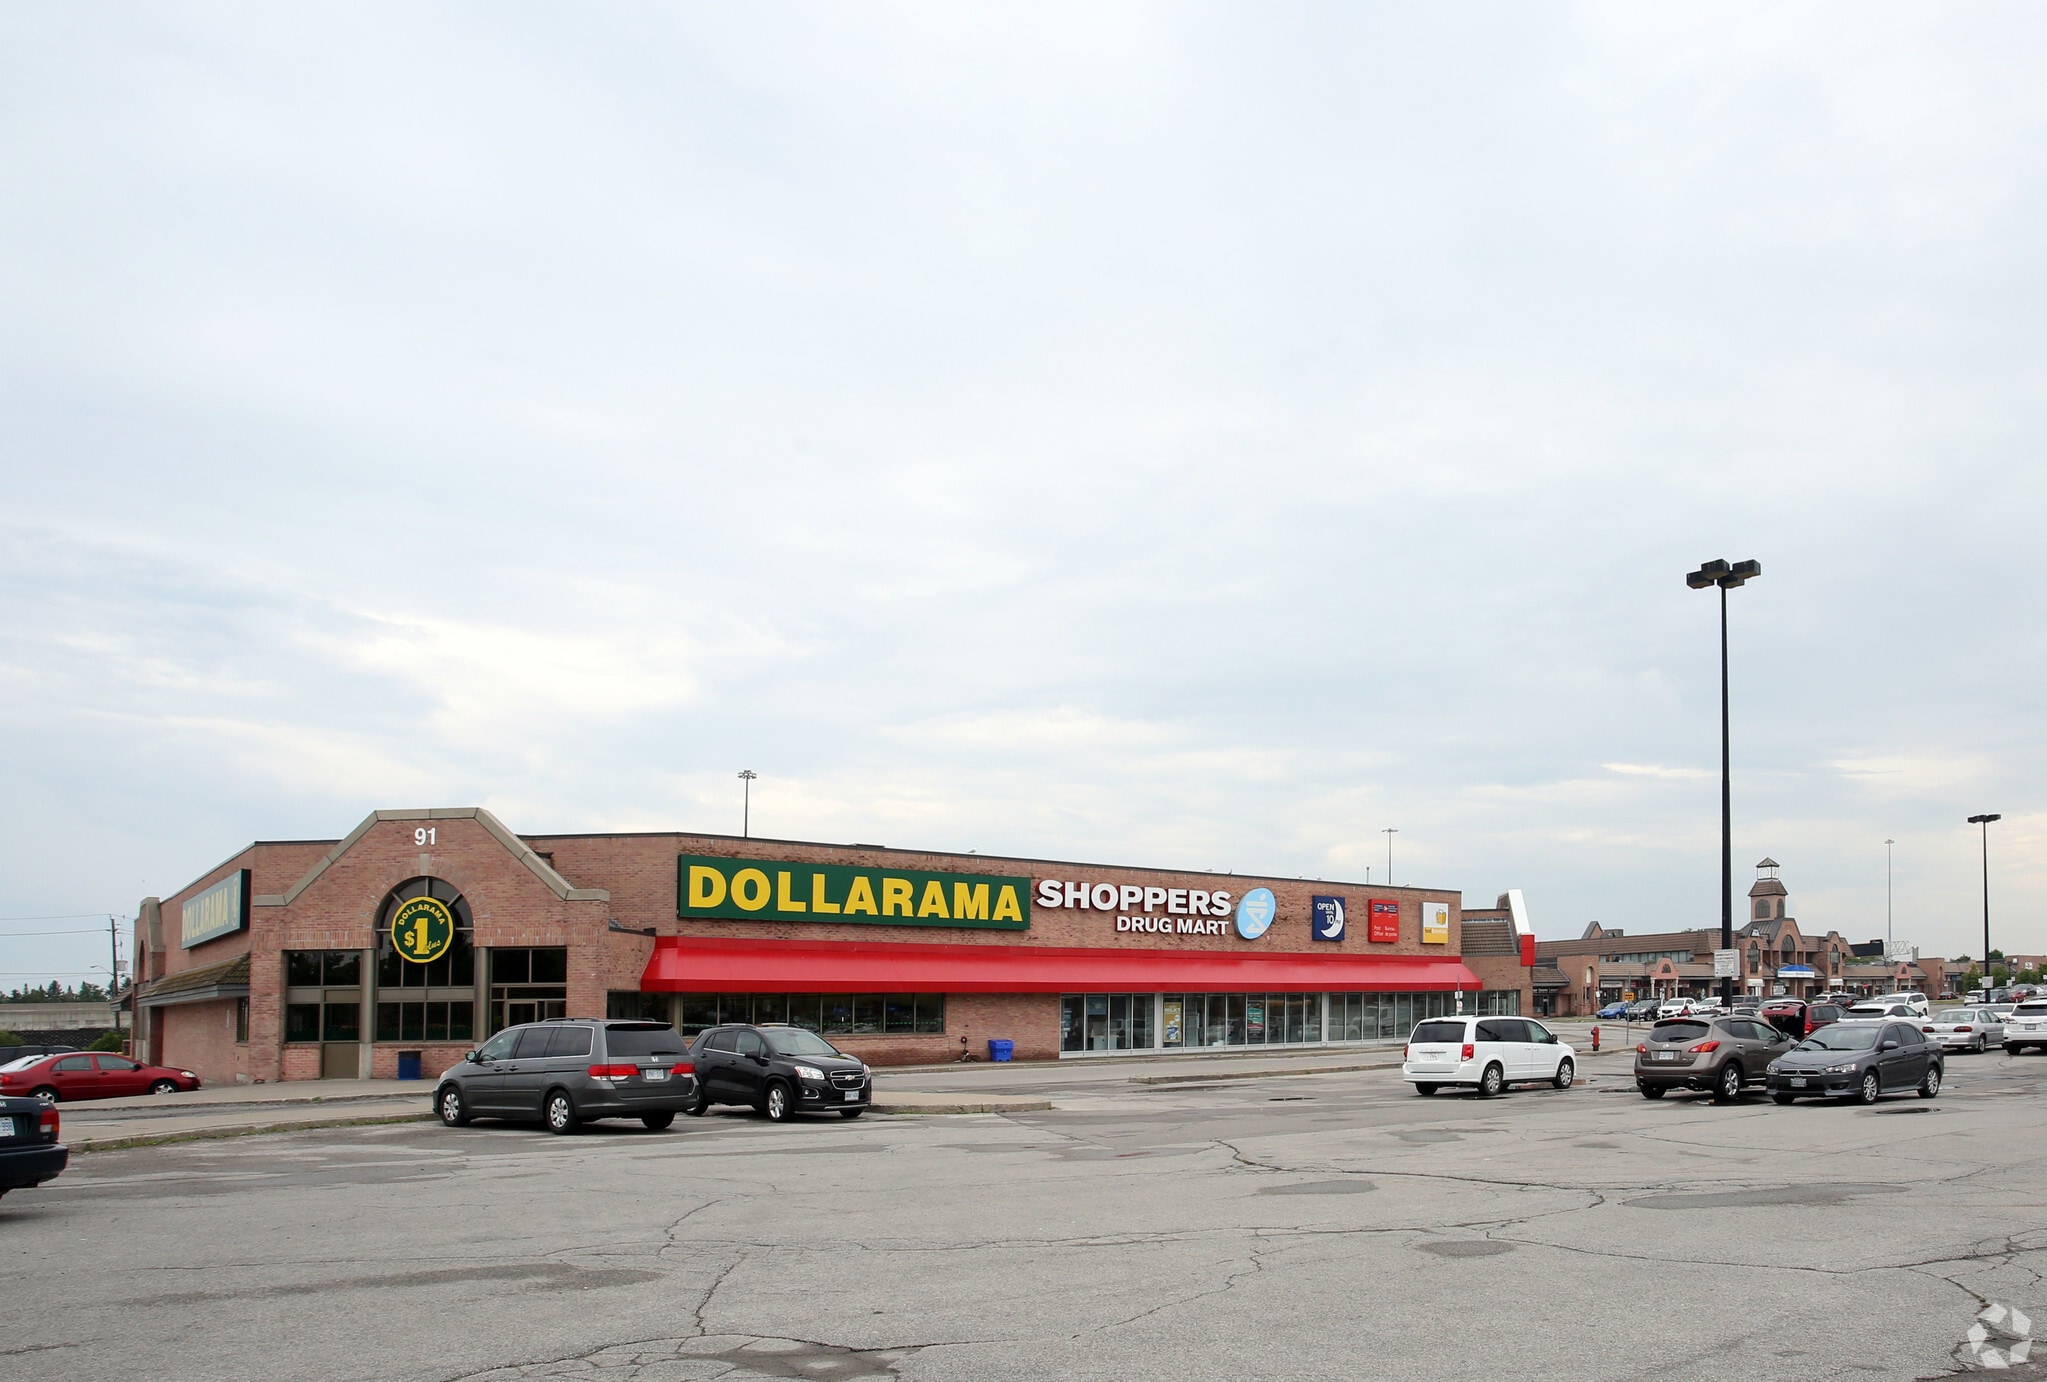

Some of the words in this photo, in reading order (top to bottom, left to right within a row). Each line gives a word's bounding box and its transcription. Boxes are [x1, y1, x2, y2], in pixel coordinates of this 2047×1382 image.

[414, 827, 436, 846] 91
[688, 865, 1024, 922] DOLLARAMA
[1036, 879, 1232, 916] SHOPPERS
[398, 903, 446, 926] DOLLARAMA
[1317, 902, 1335, 911] OPEN
[1116, 915, 1173, 933] DRUG
[1176, 917, 1229, 935] MART
[1326, 914, 1335, 925] 10
[404, 917, 430, 955] $1
